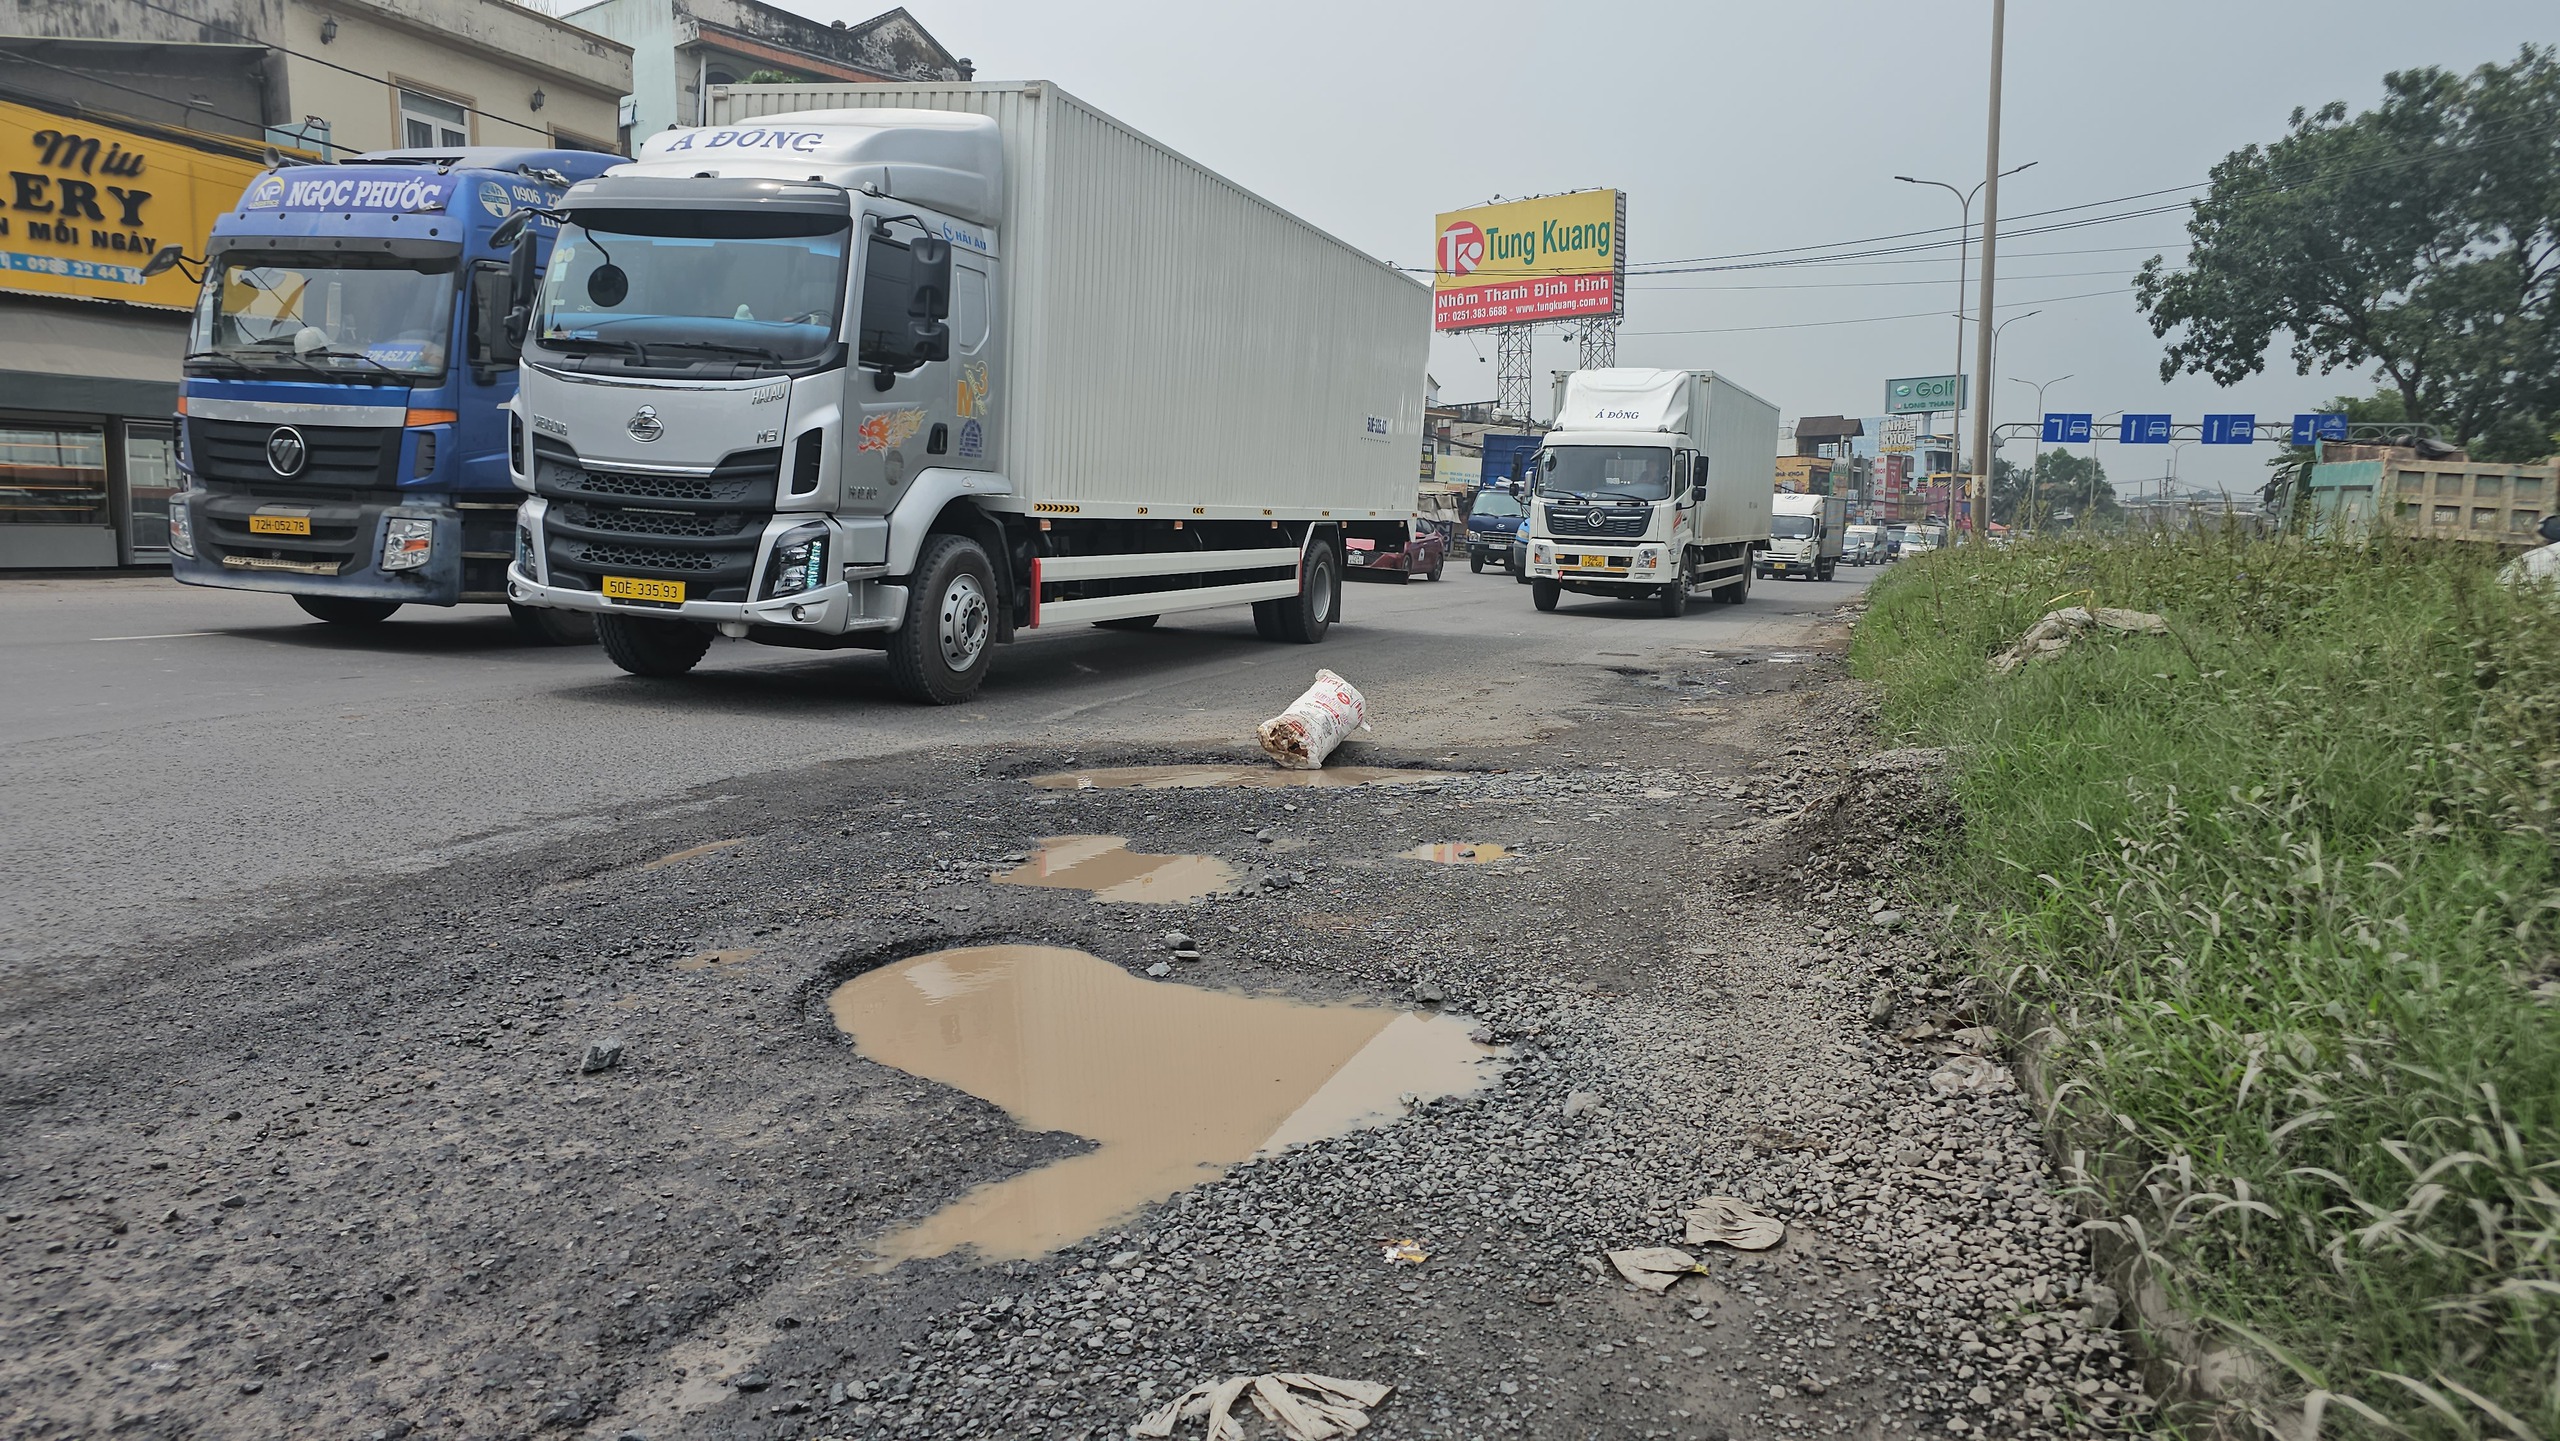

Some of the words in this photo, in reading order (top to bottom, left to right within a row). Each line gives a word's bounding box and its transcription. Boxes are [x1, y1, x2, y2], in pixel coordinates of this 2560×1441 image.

[665, 130, 706, 153] Á
[705, 129, 824, 153] ĐÔNG
[33, 128, 148, 177] Miu
[0, 170, 153, 227] ERY
[286, 180, 354, 212] NGỌC
[352, 176, 442, 211] PHƯỚC
[512, 185, 541, 205] 0906
[91, 230, 157, 255] NGÀY
[1486, 227, 1535, 265] Tung
[1543, 219, 1610, 257] Kuang
[73, 262, 94, 277] 22
[1438, 293, 1479, 309] Nhôm
[1484, 286, 1528, 303] Thanh
[1534, 281, 1568, 298] Định
[1574, 277, 1609, 293] Hình
[1452, 305, 1507, 321] 0251.383.6688
[1515, 296, 1609, 314] www.tungkuang.com.vn
[1916, 380, 1955, 398] Golf
[1595, 408, 1605, 419] Á
[1903, 402, 1926, 410] LONG
[756, 428, 778, 444] M3
[255, 519, 305, 532] 72H-052.78
[610, 580, 678, 599] 50E-335.93
